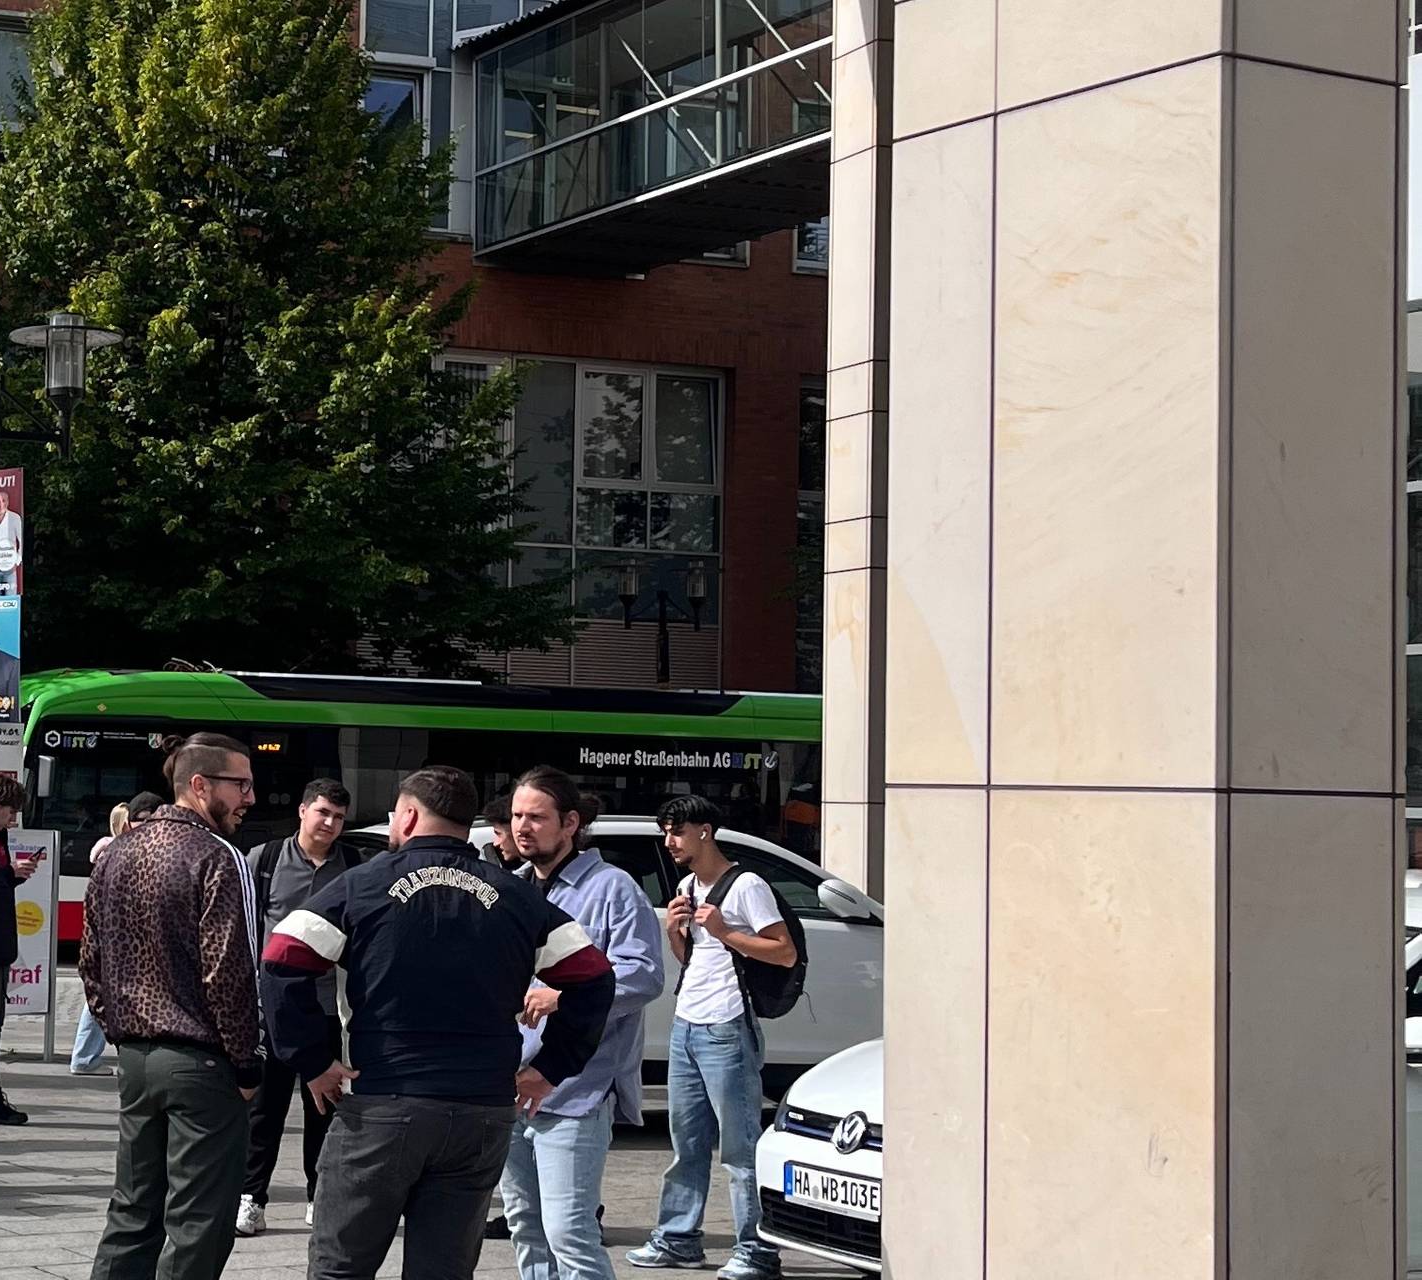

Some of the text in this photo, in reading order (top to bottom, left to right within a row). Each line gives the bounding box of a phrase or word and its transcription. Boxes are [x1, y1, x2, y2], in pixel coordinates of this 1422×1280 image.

[580, 747, 632, 768] Hagener
[634, 749, 710, 768] Straßenbahn
[712, 752, 731, 768] AG
[388, 866, 500, 910] TRABZONSPOR
[10, 964, 42, 984] raf
[794, 1169, 811, 1197] HA
